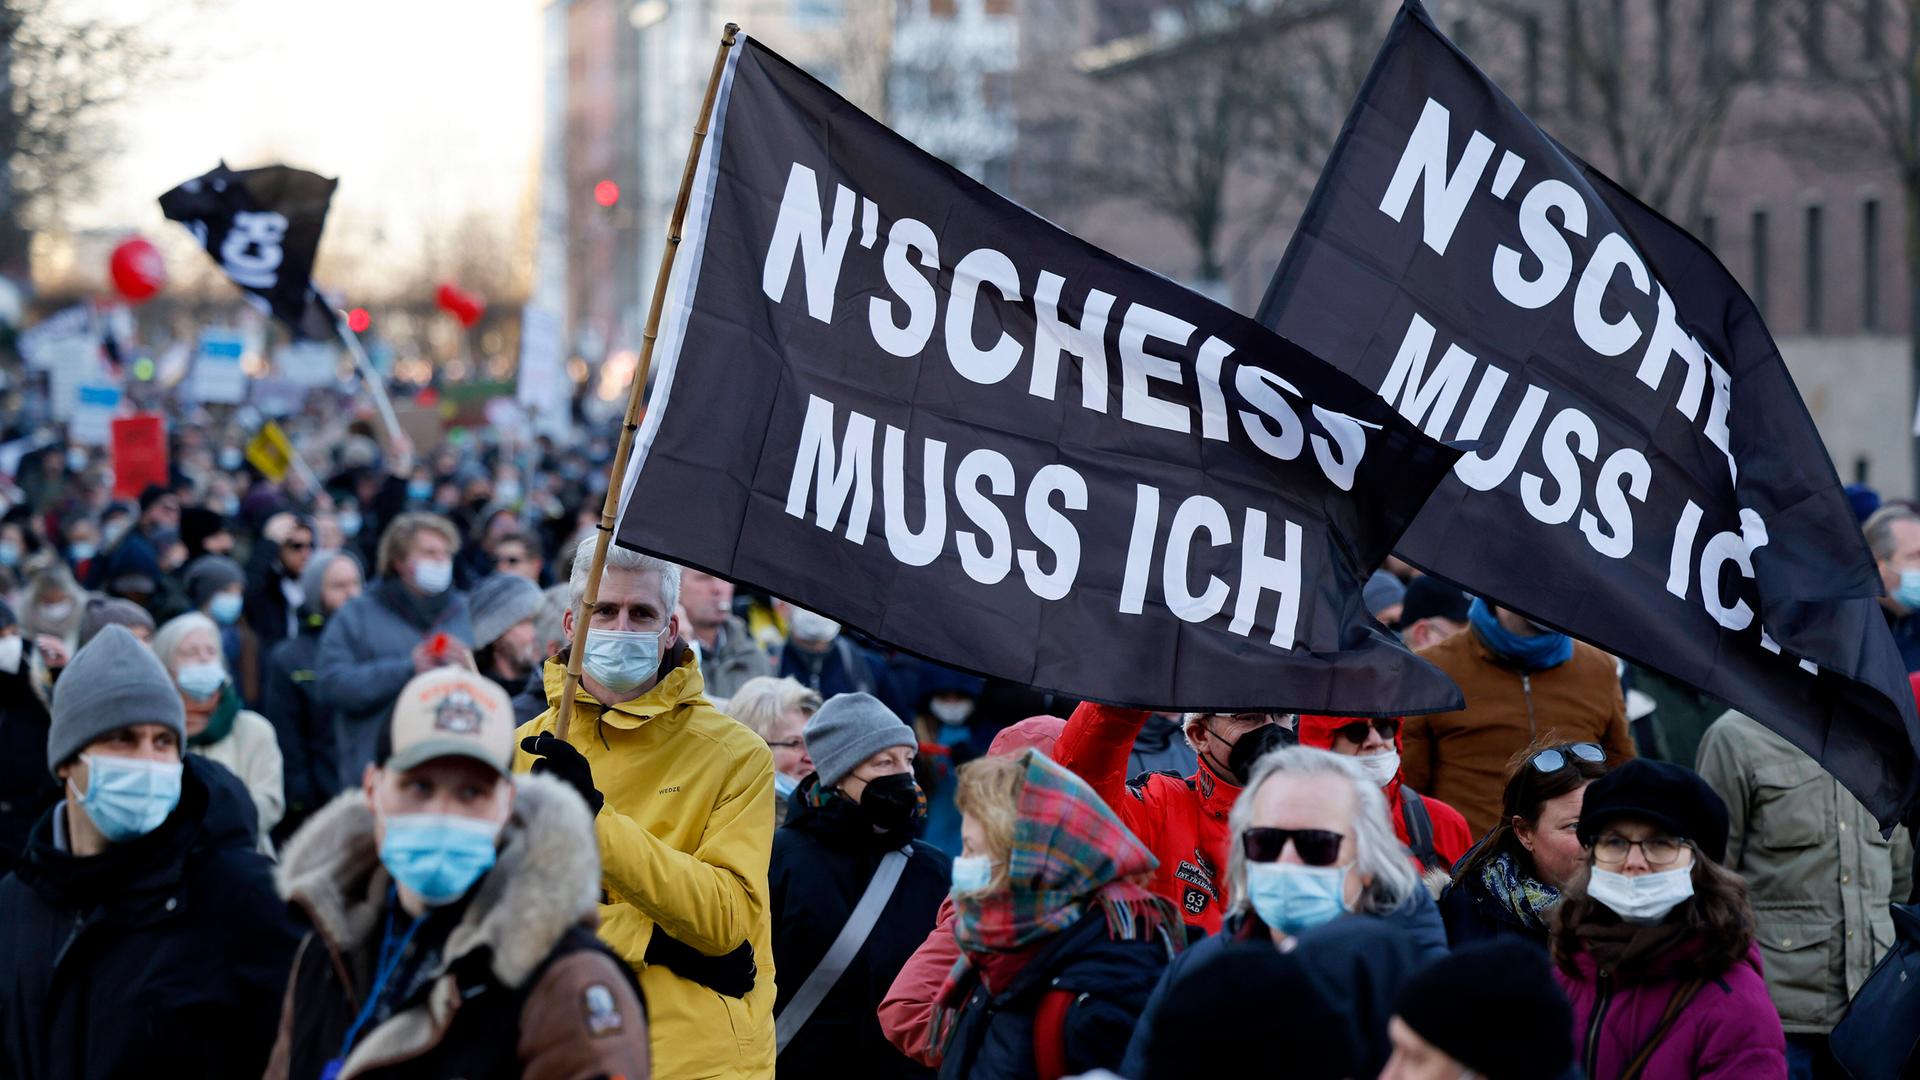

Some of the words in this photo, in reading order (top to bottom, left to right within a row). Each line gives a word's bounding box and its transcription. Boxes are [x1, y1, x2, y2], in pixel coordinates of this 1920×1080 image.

[763, 162, 1383, 491] N'SCHEISS
[785, 394, 1088, 600] MUSS
[1119, 484, 1303, 650] ICH
[1377, 313, 1651, 558] MUSS
[1667, 499, 1818, 675] IC
[659, 786, 680, 795] WEDZE
[1186, 903, 1200, 913] CAD
[1187, 892, 1205, 907] 63
